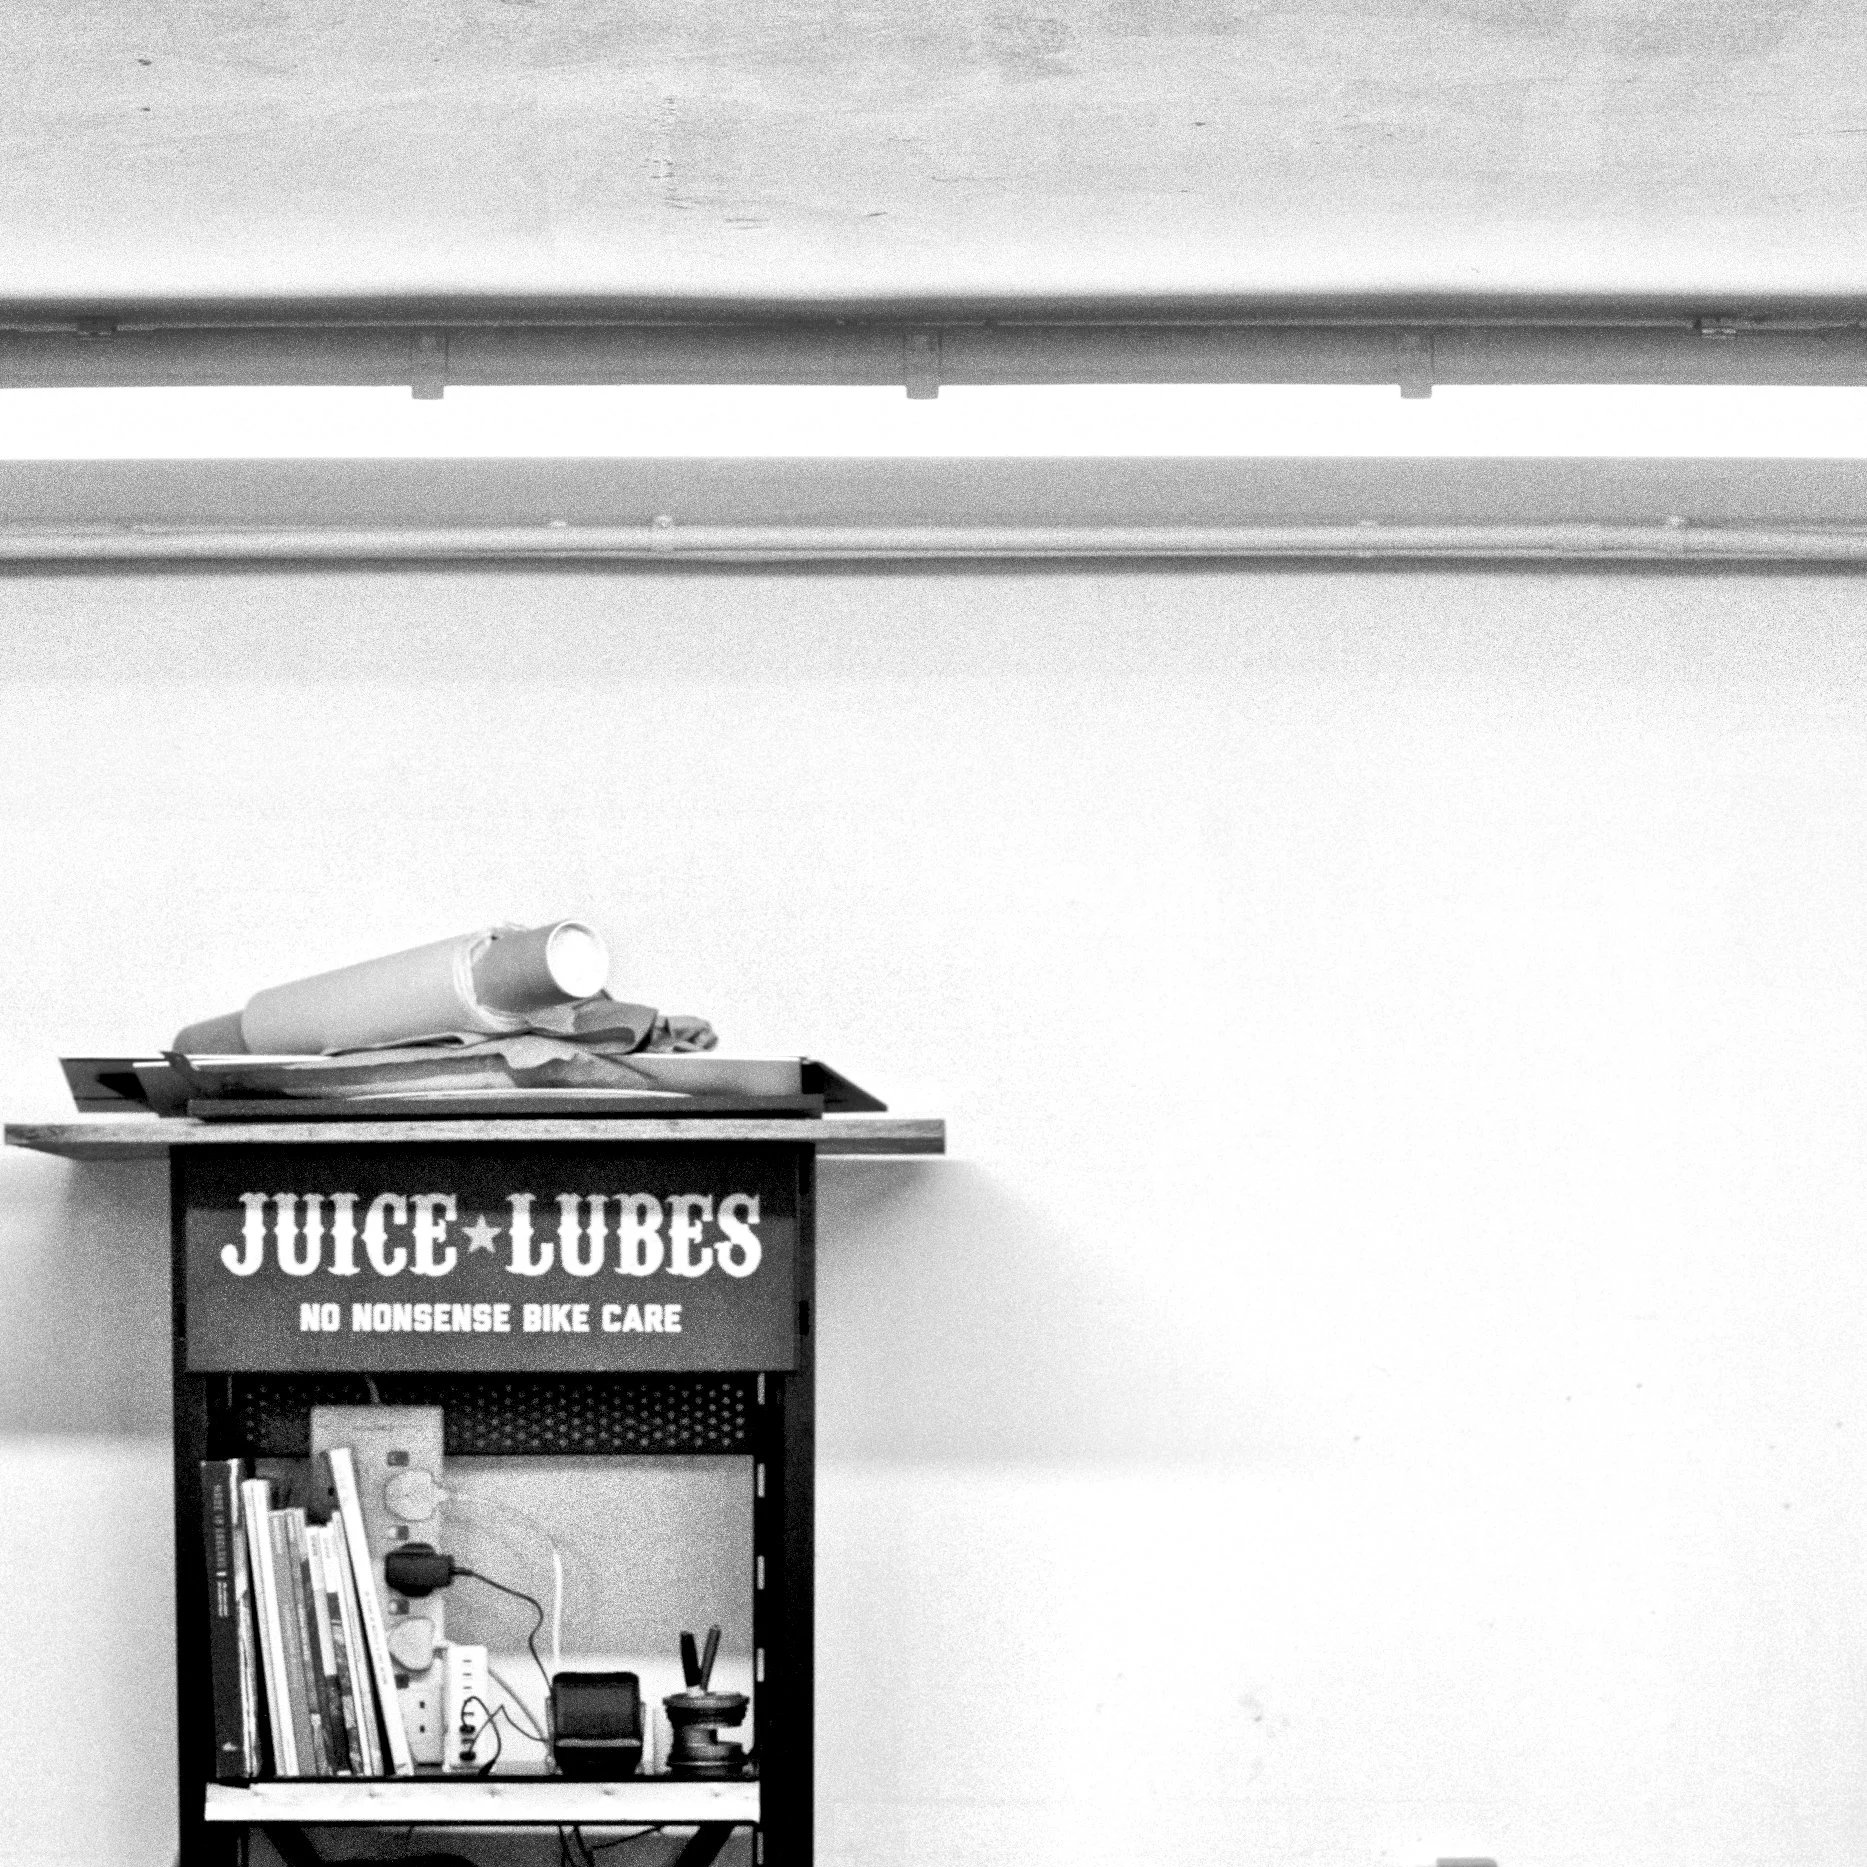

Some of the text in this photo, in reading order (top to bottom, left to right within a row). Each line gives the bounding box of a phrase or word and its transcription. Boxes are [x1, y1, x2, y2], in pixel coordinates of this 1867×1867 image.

[220, 1191, 762, 1279] JUICE LUBES
[299, 1302, 682, 1333] NO NONSENSE BIKE CARE
